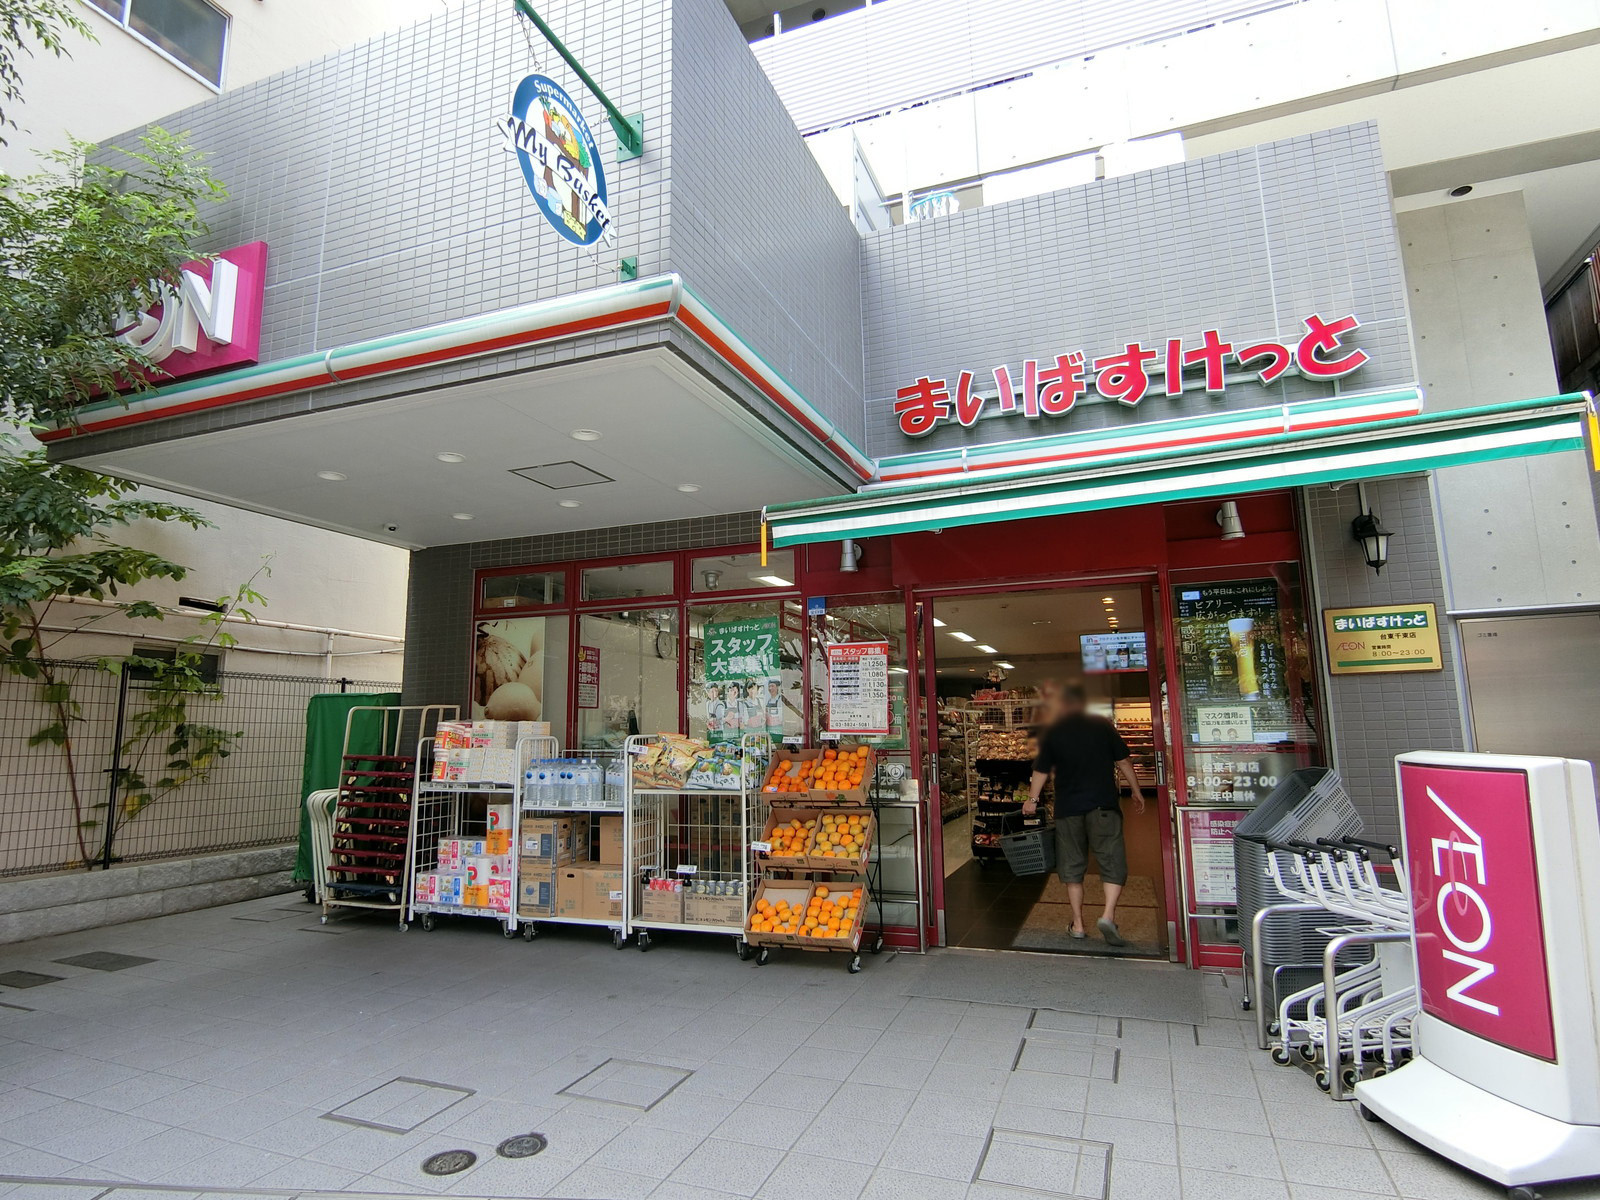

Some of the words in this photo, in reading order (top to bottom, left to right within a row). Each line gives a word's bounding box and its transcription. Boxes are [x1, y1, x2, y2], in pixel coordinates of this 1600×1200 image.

[533, 78, 594, 149] Supermarket
[507, 115, 548, 166] My
[893, 311, 1371, 439] まいばすけっと
[719, 624, 760, 635] まいばすけっと
[1334, 614, 1426, 630] まいばすけっと
[711, 633, 772, 655] スタッフ
[1211, 791, 1256, 802] 年中無休
